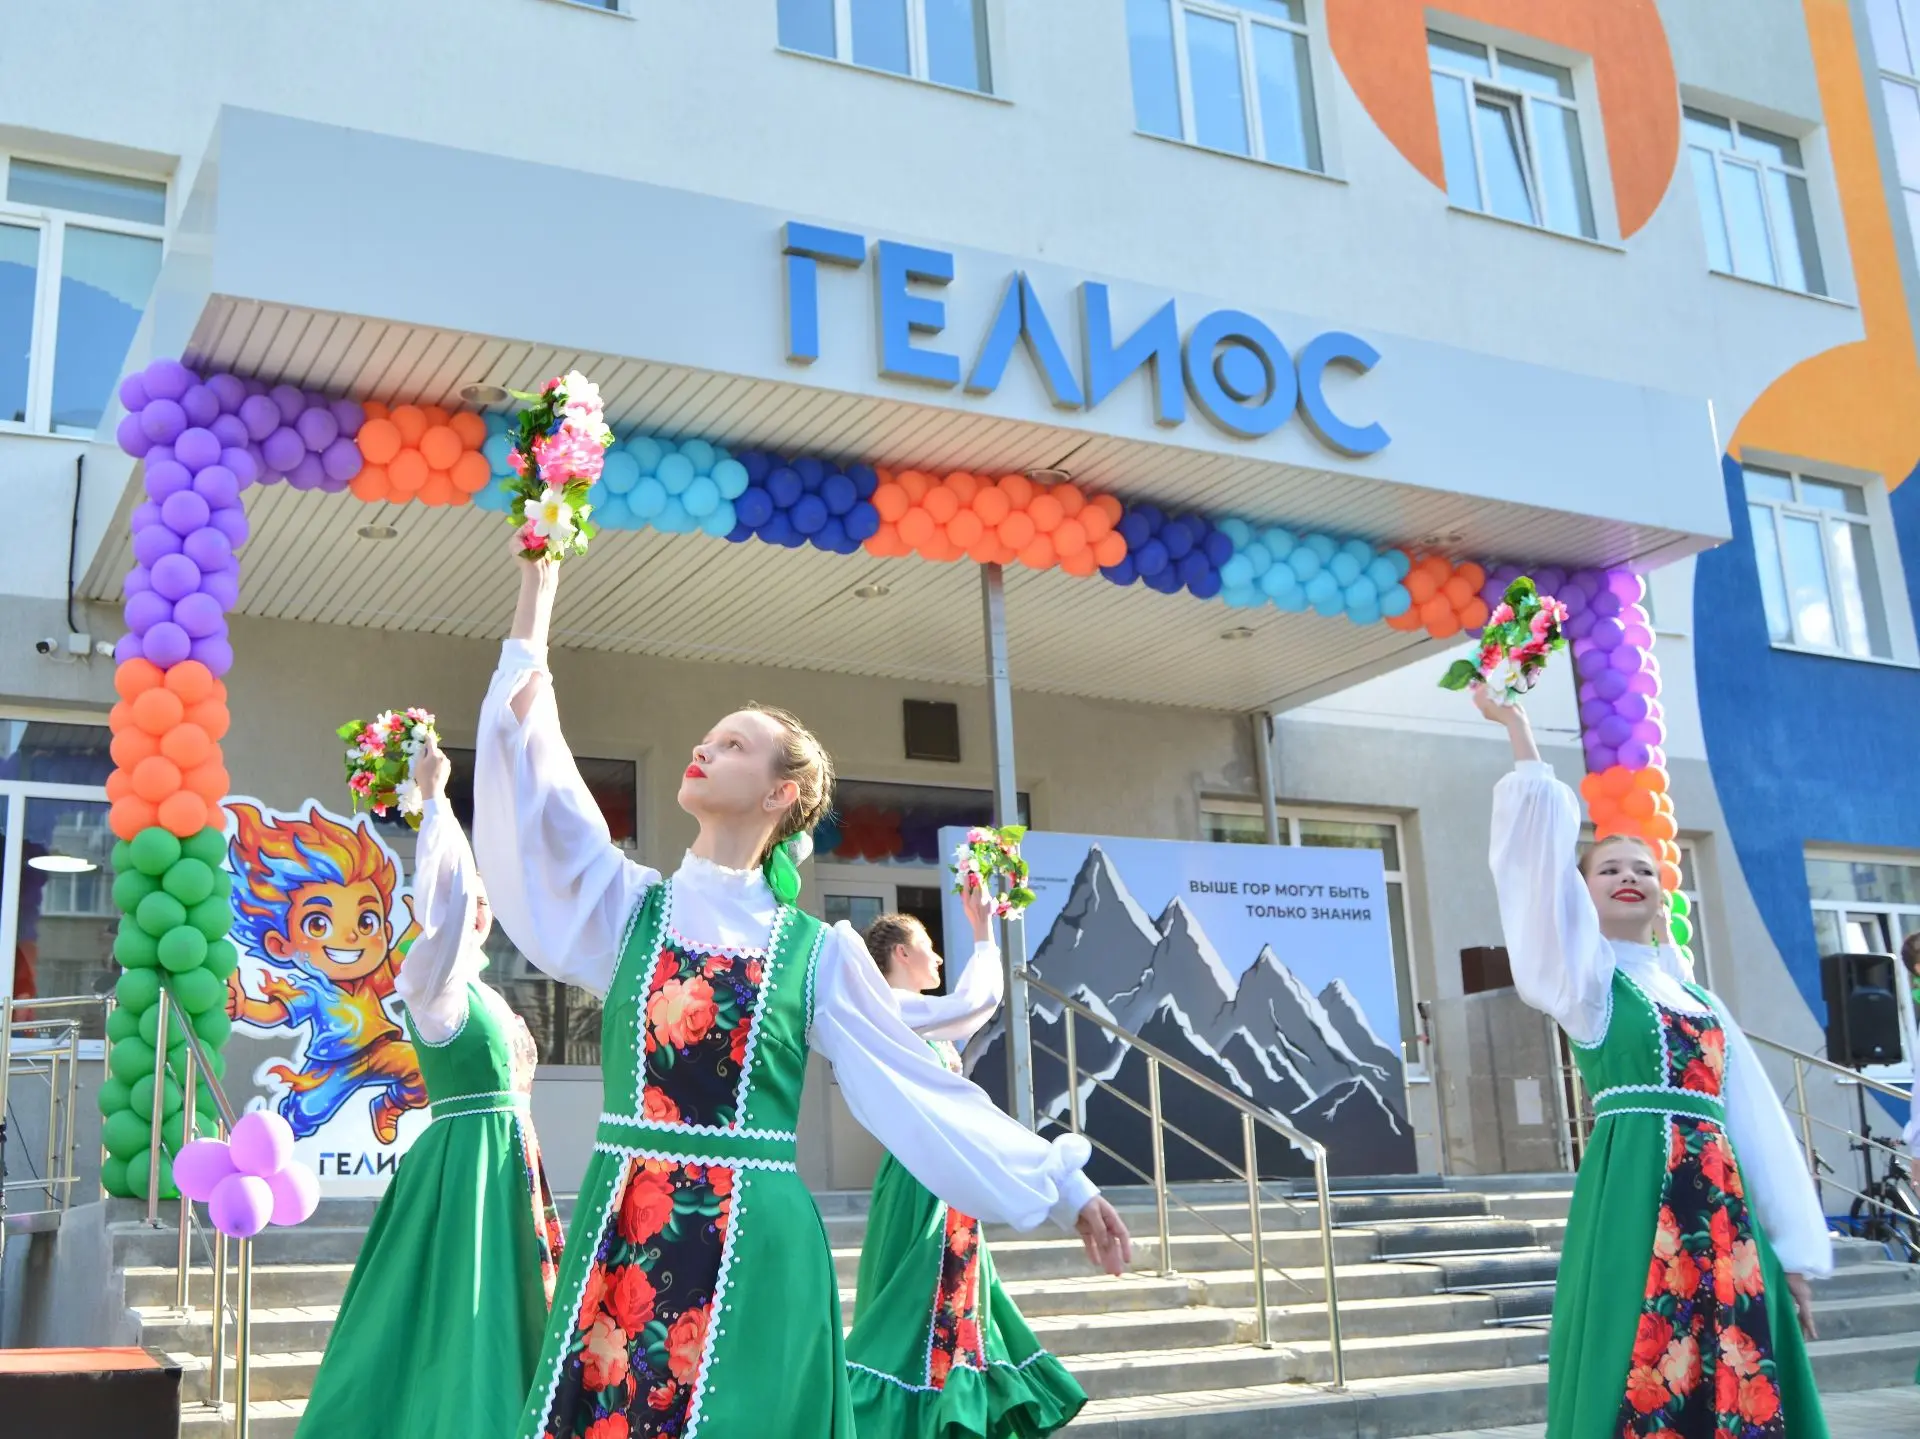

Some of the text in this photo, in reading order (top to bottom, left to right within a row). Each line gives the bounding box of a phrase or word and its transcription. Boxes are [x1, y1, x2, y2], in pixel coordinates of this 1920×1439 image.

[782, 221, 1391, 457] ГЕЛИОС
[1189, 880, 1370, 899] ВЫШЕ ГОР МОГУТ БЫТЬ
[1246, 905, 1371, 921] ТОЛЬКО ЗНАНИЯ
[319, 1152, 405, 1175] ГЕЛИ
